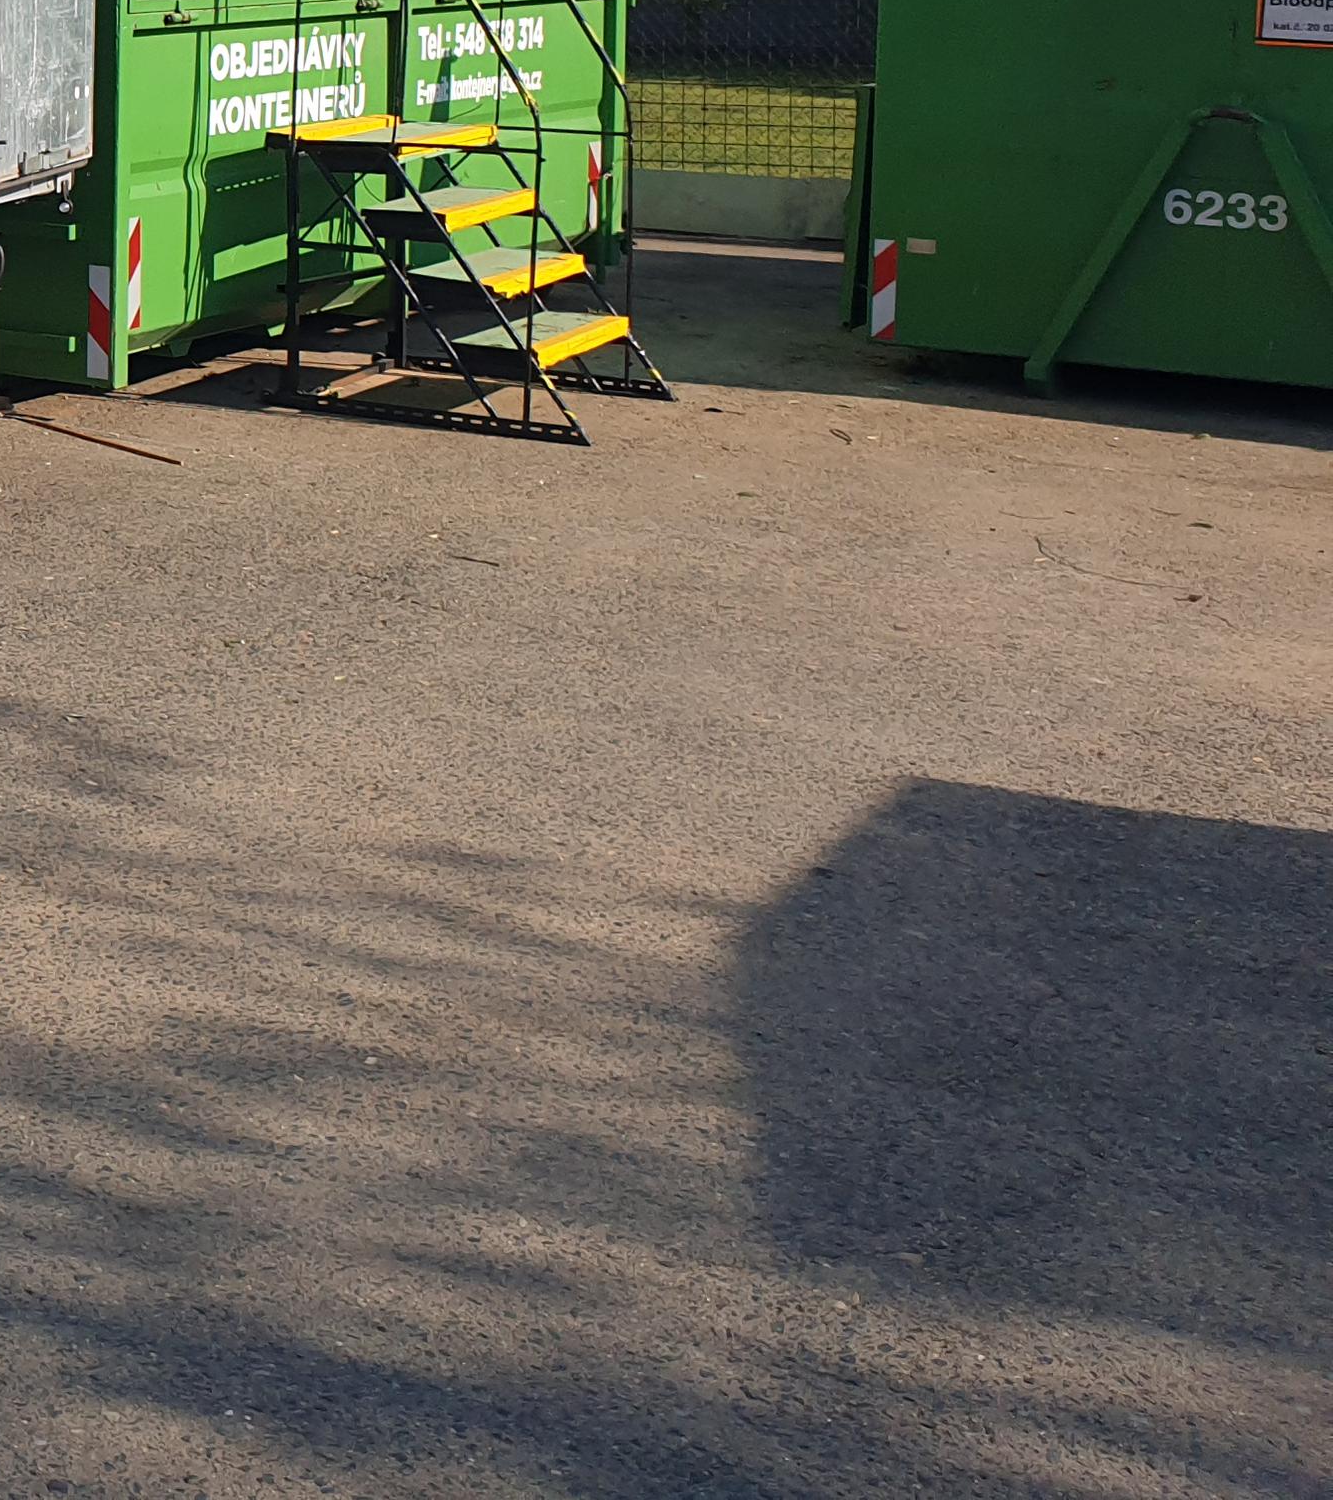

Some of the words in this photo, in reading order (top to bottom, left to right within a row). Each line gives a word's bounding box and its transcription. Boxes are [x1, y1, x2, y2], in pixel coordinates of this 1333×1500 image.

[210, 26, 366, 81] OBJEDNÁVKY
[418, 23, 452, 61] Tel.:
[454, 21, 486, 57] 548
[517, 16, 544, 51] 314
[209, 70, 366, 136] KONTEJNERŮ
[1163, 188, 1288, 232] 6233
